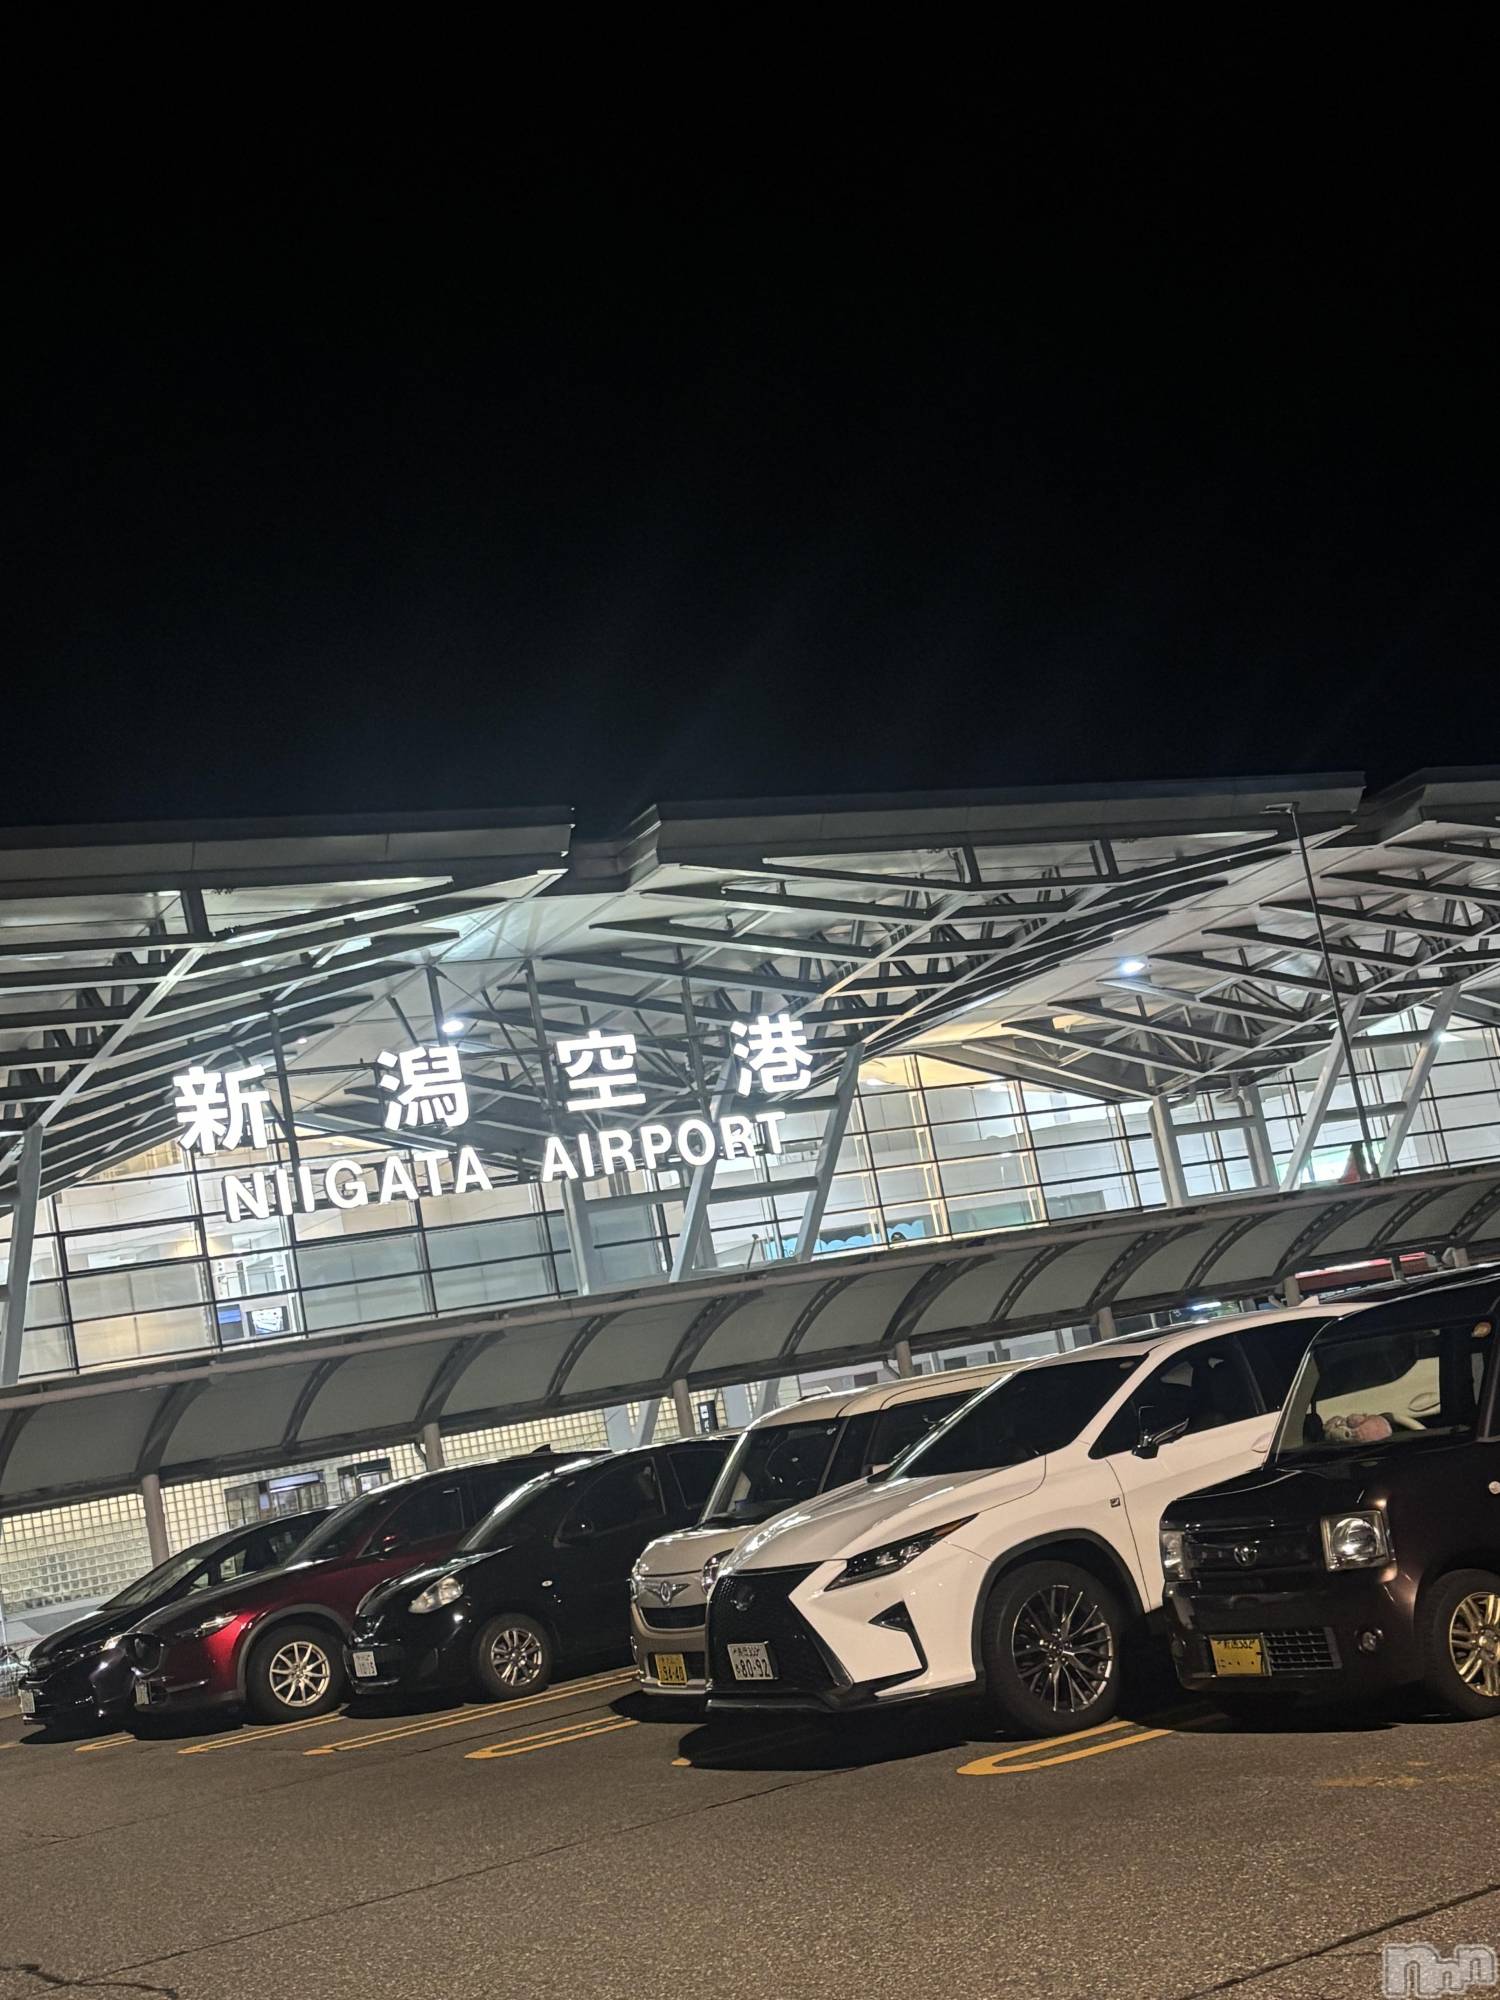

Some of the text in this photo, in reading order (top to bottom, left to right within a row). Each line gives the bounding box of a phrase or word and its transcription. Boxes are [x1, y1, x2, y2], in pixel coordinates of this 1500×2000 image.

[173, 1014, 813, 1154] 新潟空港
[223, 1111, 786, 1223] NIIGATA AIRPORT
